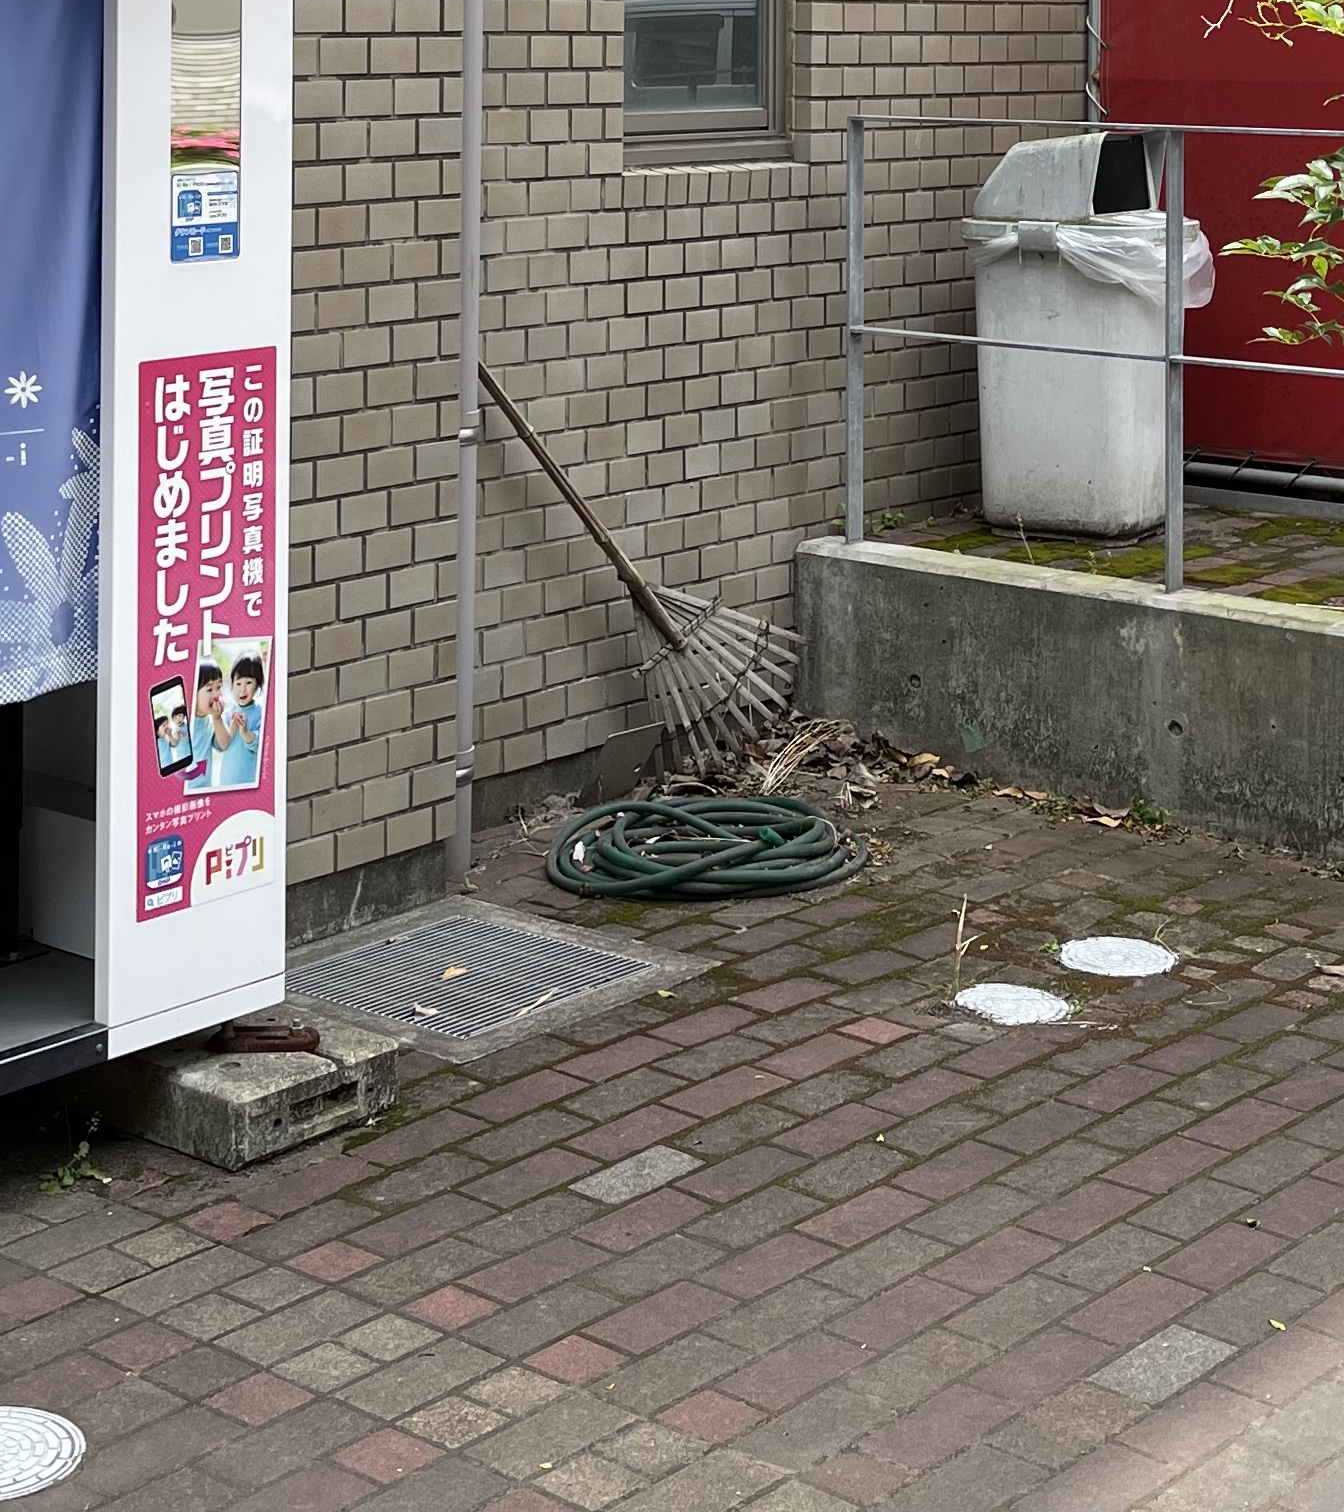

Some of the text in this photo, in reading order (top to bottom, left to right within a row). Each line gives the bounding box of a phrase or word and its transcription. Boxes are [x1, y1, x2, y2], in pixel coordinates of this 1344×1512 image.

[153, 373, 192, 666] はじめました
[198, 367, 237, 656] 写真プリント
[242, 364, 264, 617] この証明写真機で
[145, 809, 213, 836] カンタン写真プリント
